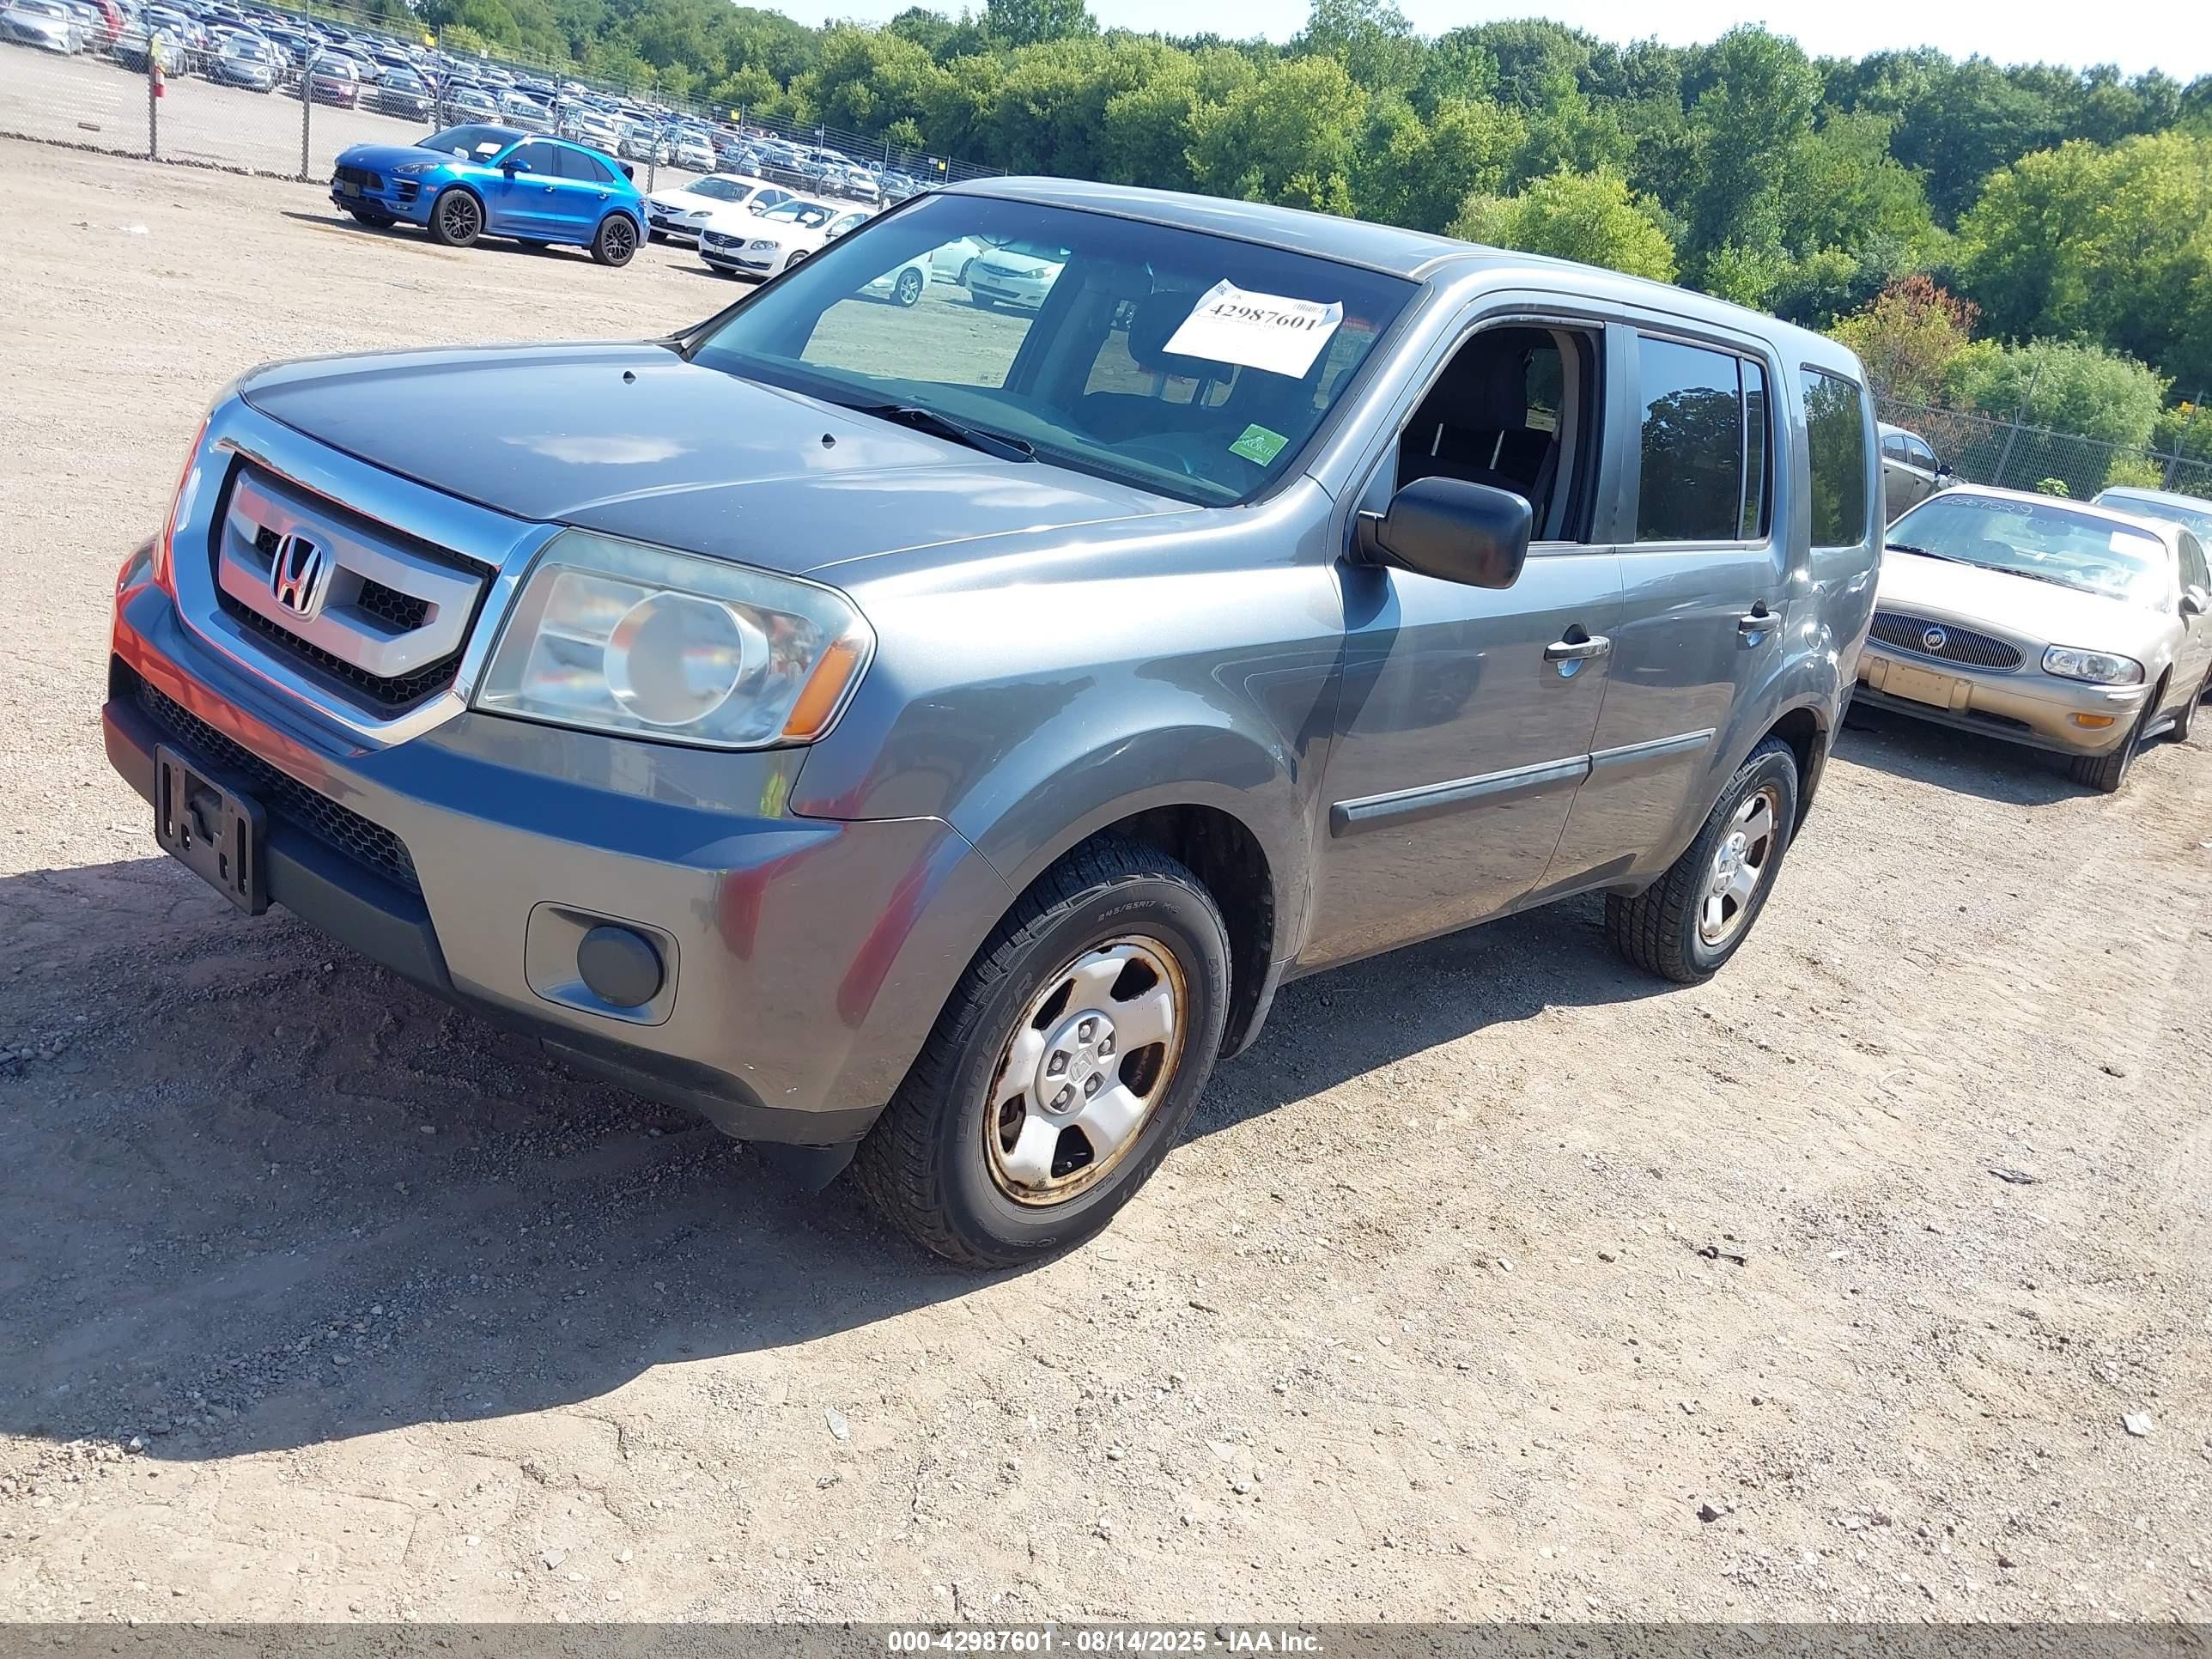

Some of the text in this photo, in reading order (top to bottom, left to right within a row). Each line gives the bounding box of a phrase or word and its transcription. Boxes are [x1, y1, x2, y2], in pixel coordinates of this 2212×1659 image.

[1209, 303, 1317, 331] 42987601
[1237, 435, 1276, 457] SKOKIE
[1097, 900, 1157, 922] 245/65R17
